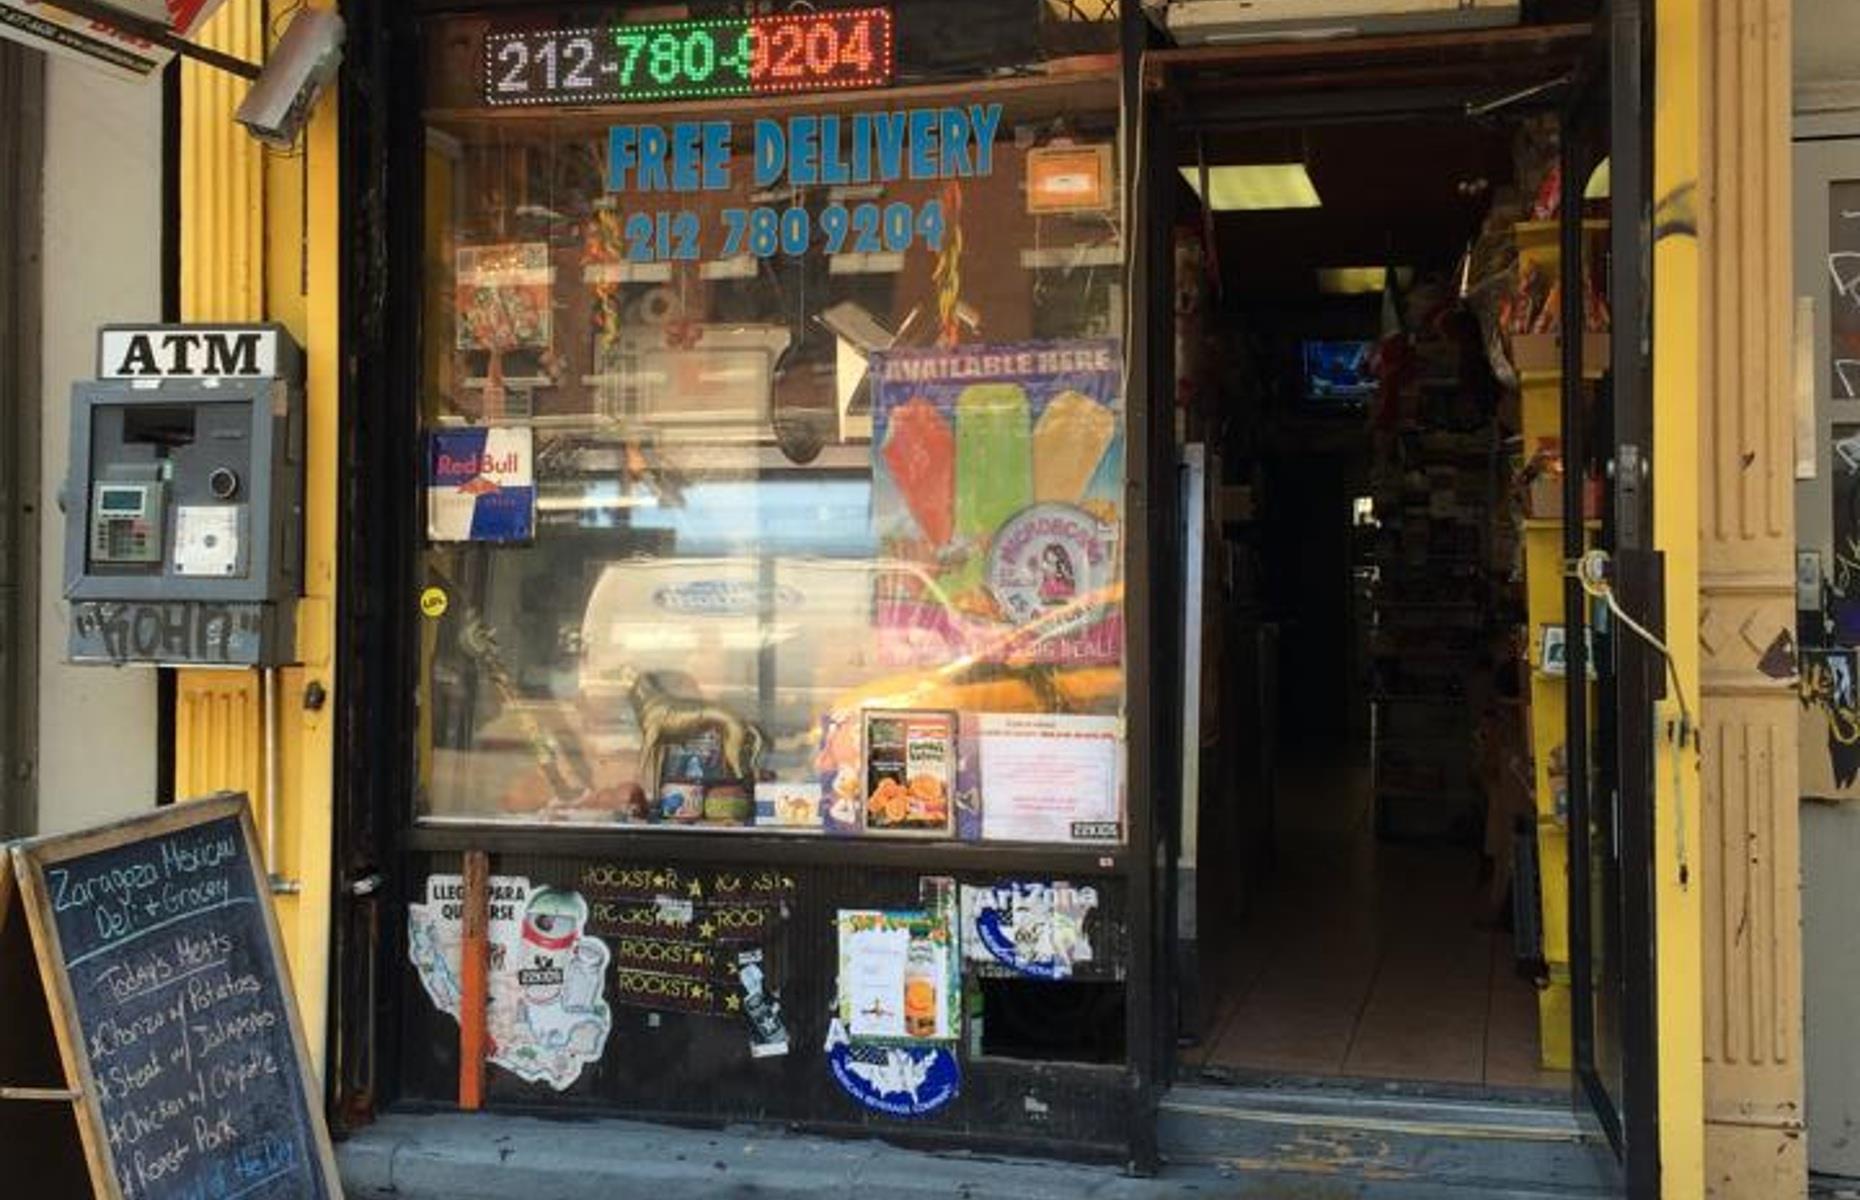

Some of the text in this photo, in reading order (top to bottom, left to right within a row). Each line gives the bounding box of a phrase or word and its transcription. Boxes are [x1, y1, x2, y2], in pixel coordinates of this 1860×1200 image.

[497, 20, 874, 92] 212-780-9204
[607, 103, 1003, 193] FREE DELIVERY
[624, 199, 945, 262] 212 780 9204
[117, 333, 262, 376] ATM
[885, 349, 1113, 382] AVAILABLE HERE
[436, 453, 518, 475] Red Bull
[49, 864, 159, 912] Zaragoza
[95, 903, 138, 939] Deli
